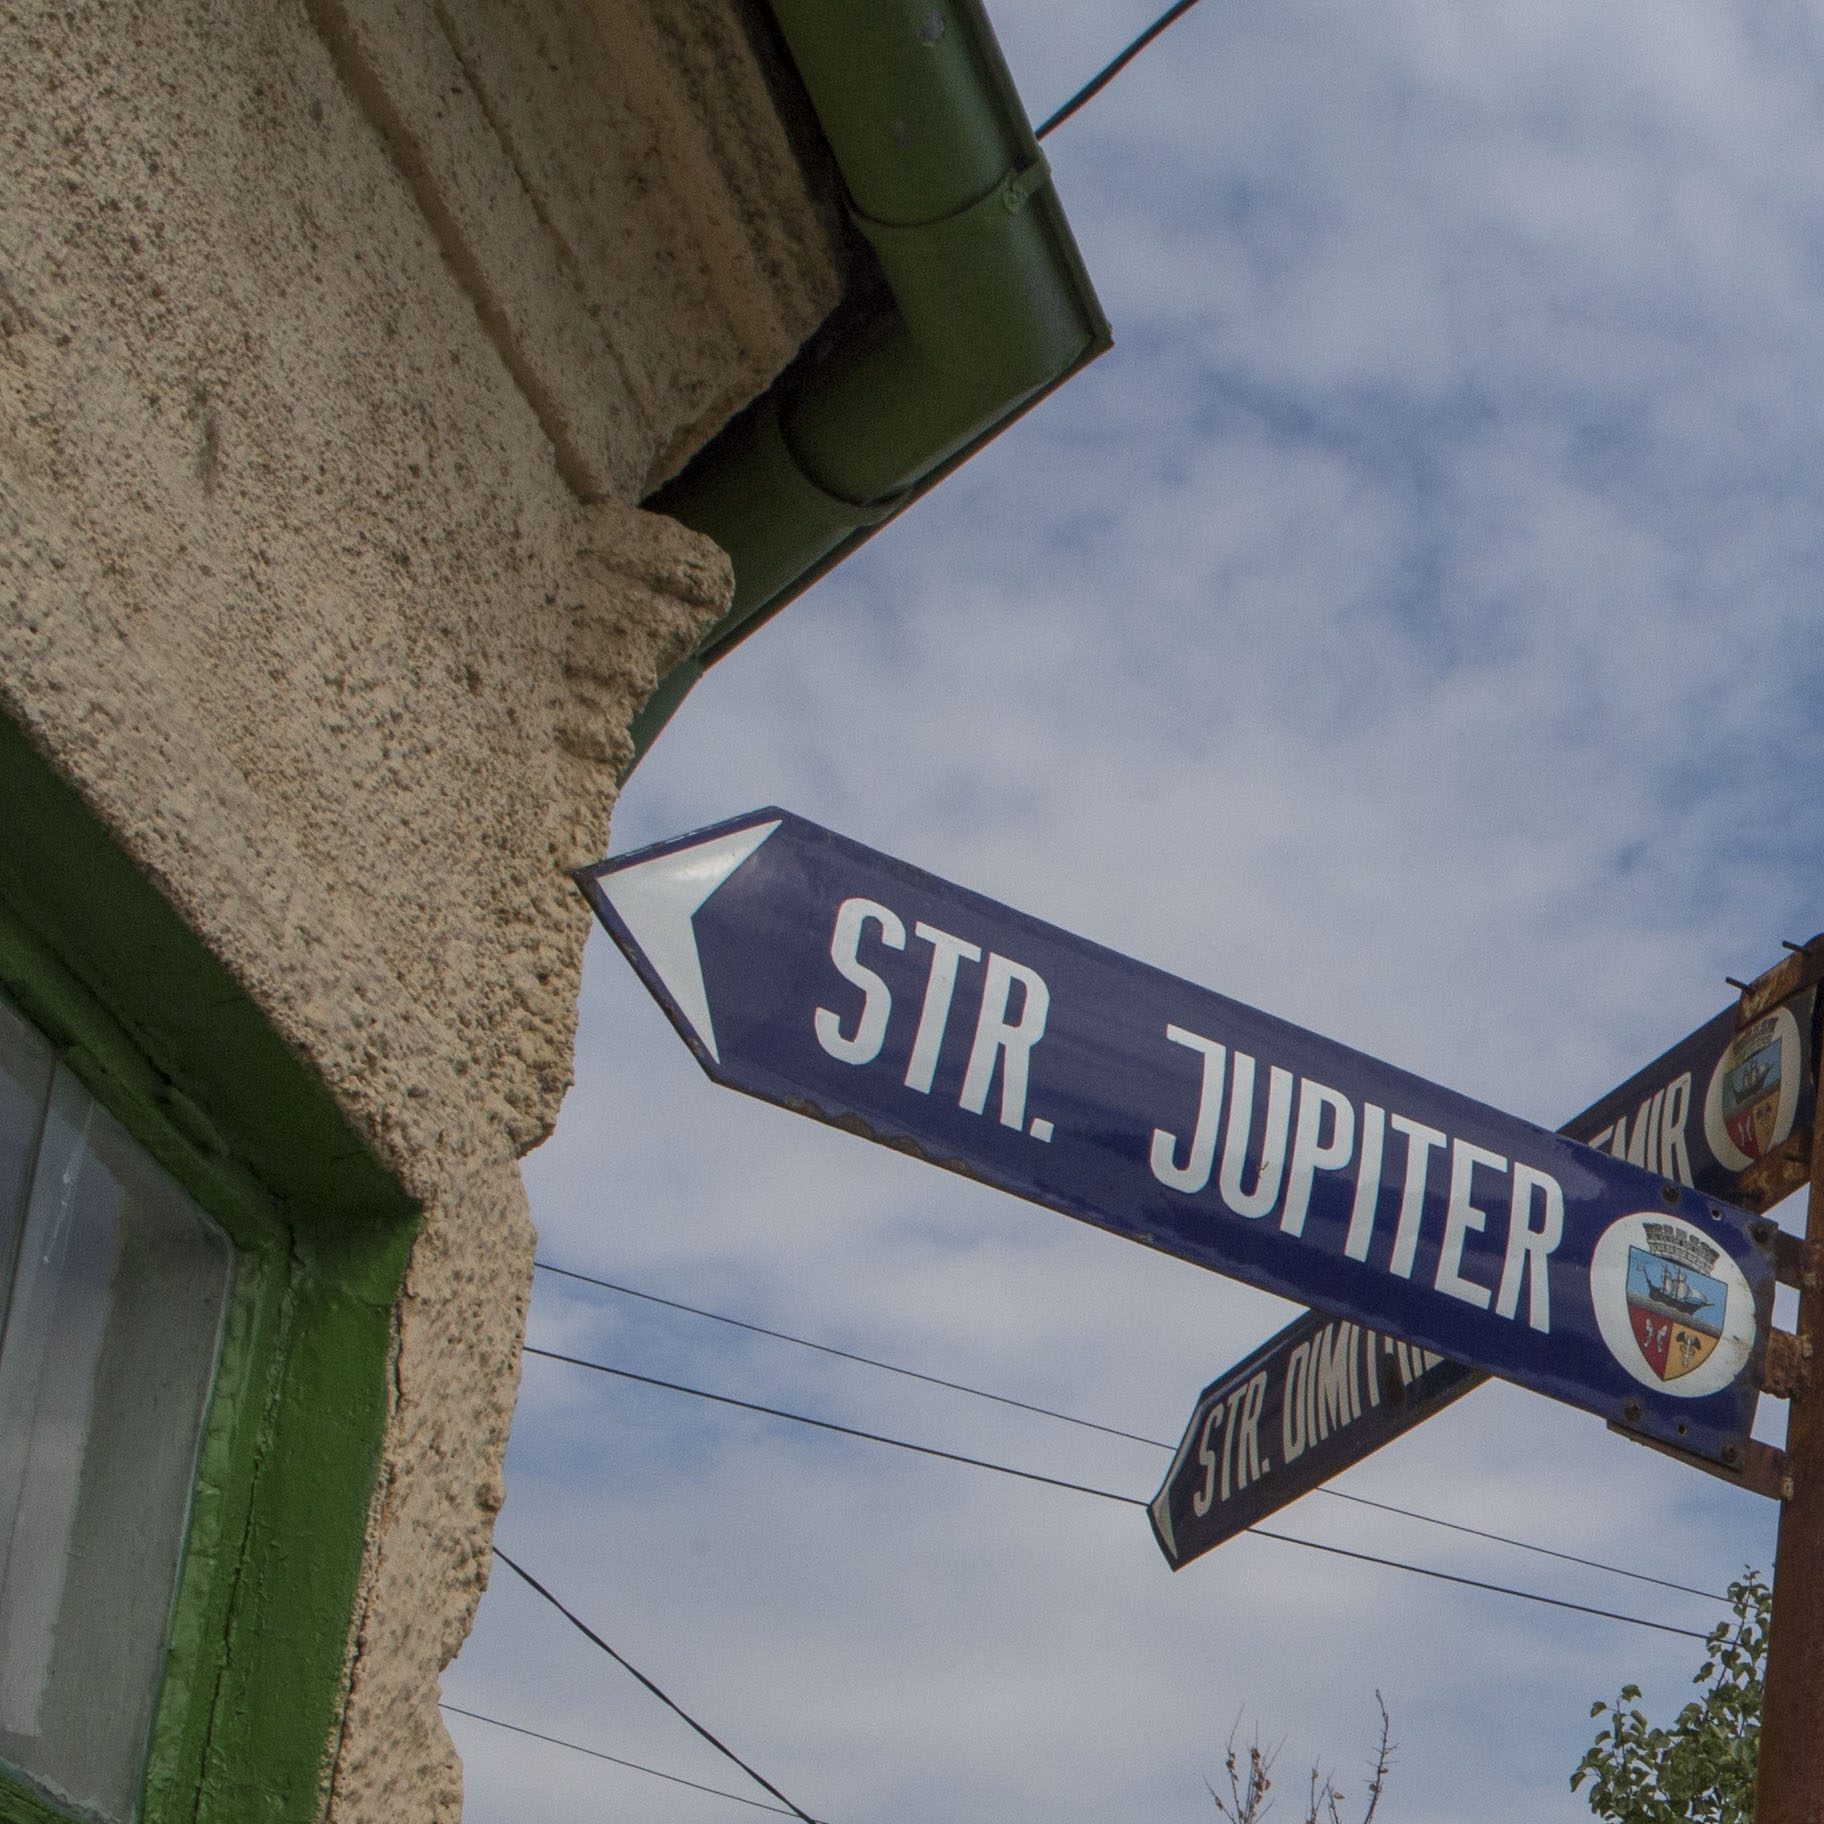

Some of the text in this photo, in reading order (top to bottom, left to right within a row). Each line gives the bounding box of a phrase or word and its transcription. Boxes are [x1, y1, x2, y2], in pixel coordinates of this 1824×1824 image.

[813, 896, 1565, 1334] STR. JUPITER
[1193, 1370, 1271, 1518] STR.
